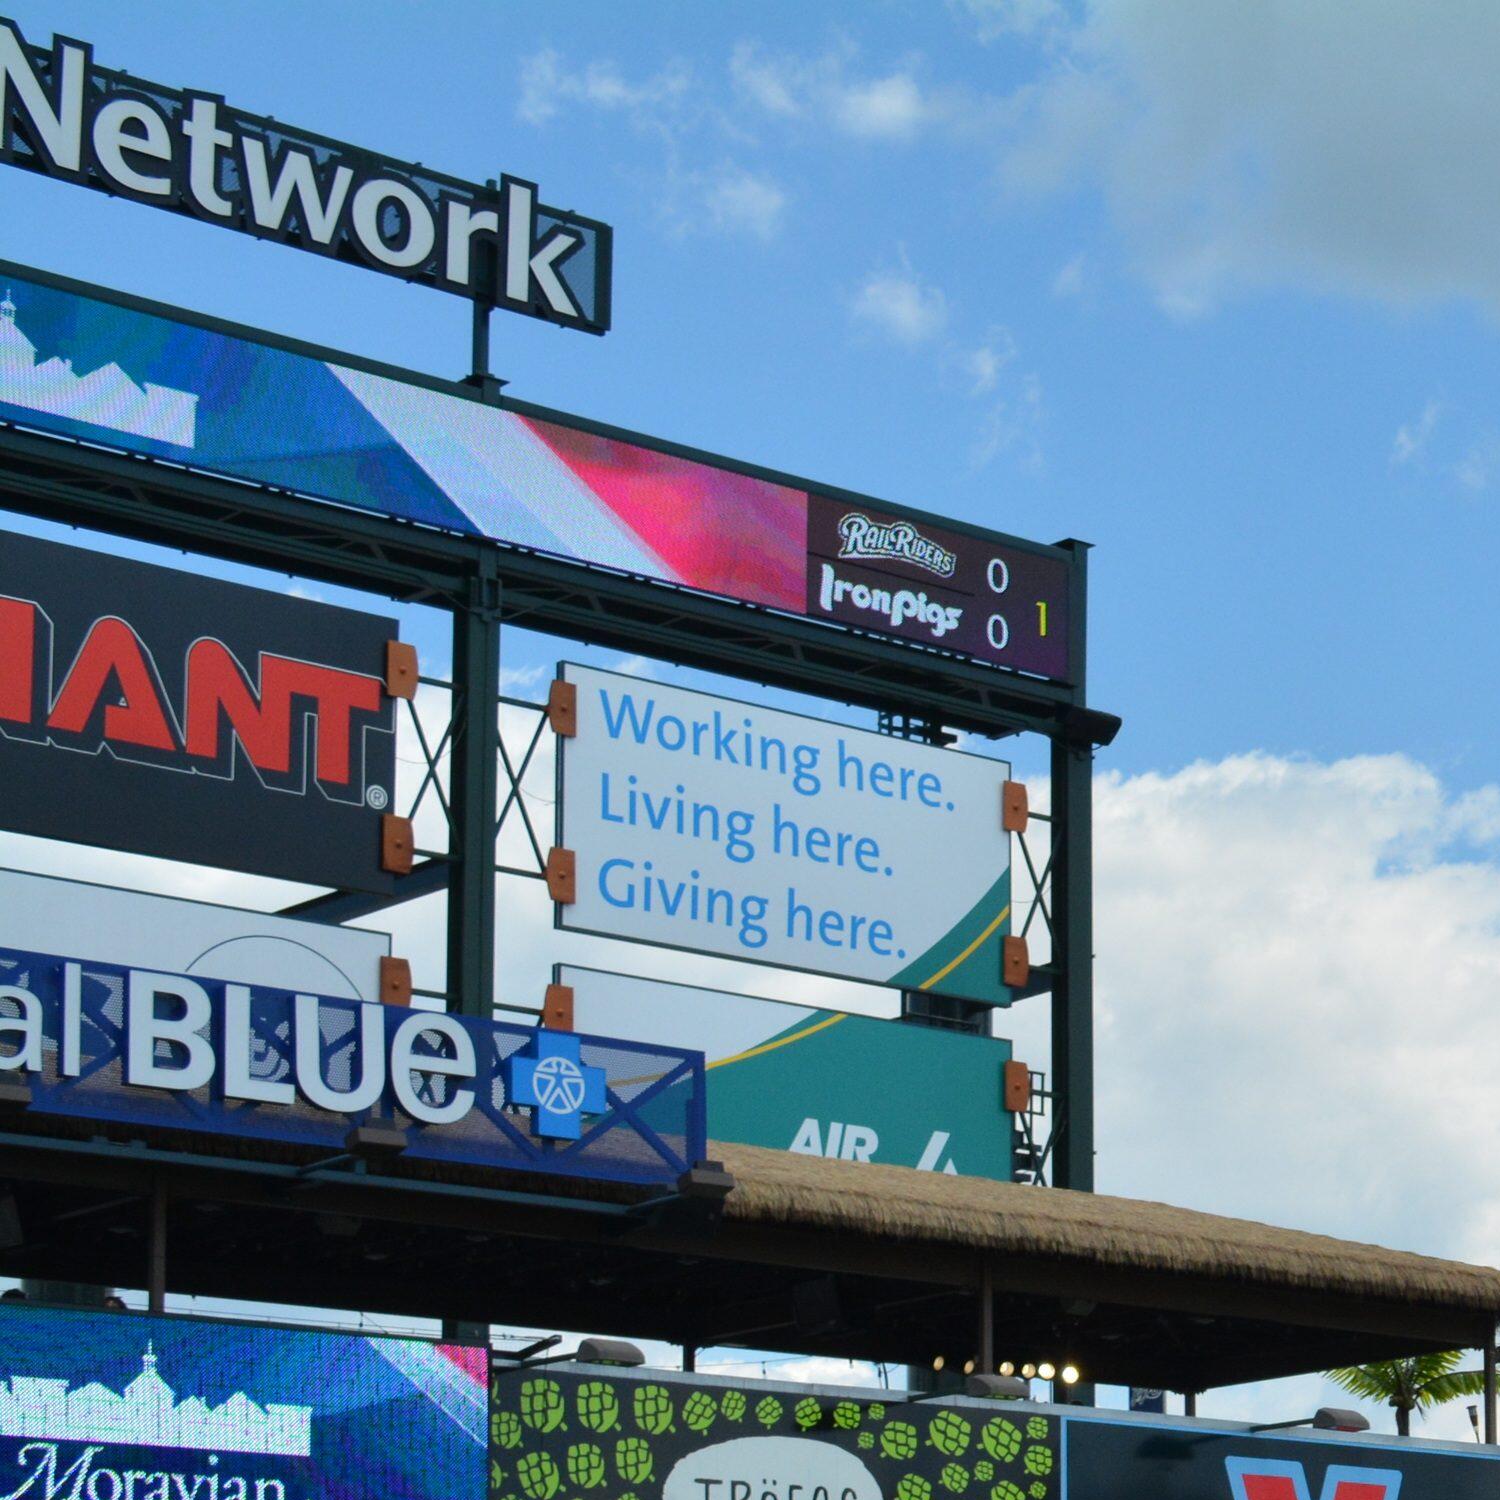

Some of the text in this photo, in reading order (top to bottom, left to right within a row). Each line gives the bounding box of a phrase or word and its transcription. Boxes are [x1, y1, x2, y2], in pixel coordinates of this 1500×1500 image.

[0, 25, 582, 318] Network
[987, 558, 1009, 593] 0
[1036, 601, 1048, 637] 1
[987, 614, 1009, 650] 0
[600, 688, 955, 812] Working here.
[600, 772, 894, 877] Living here.
[599, 858, 907, 959] Giving here.
